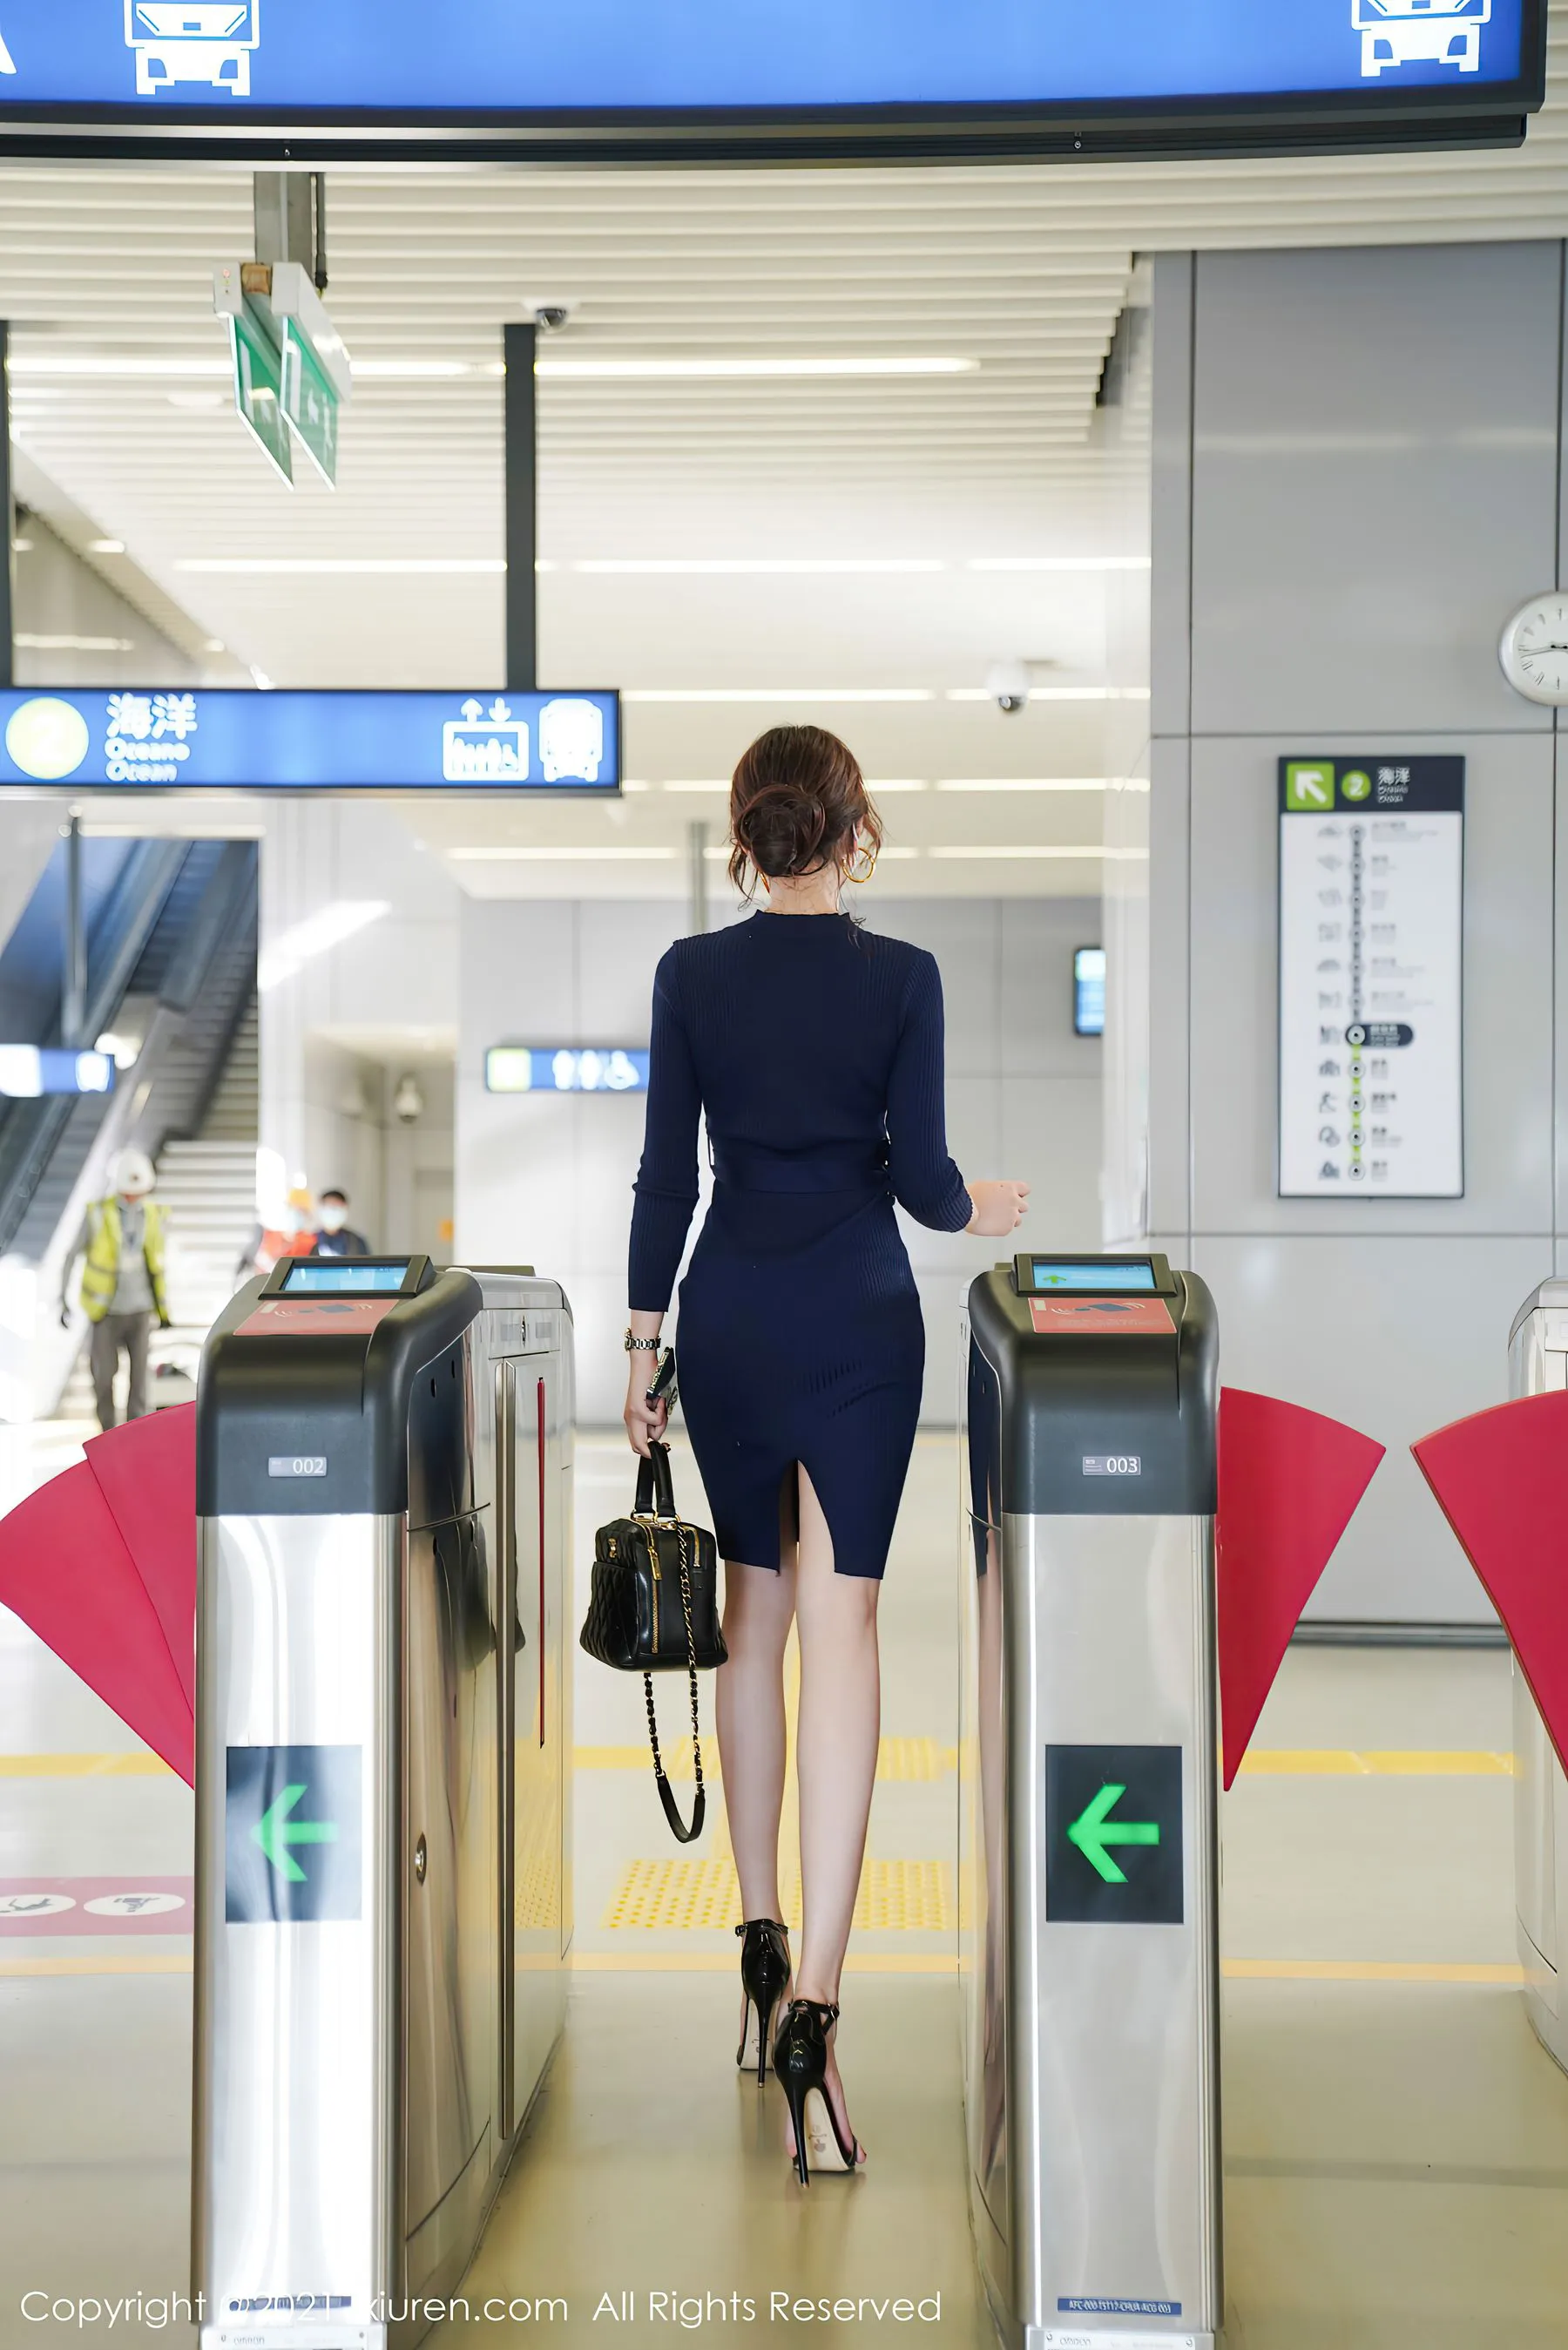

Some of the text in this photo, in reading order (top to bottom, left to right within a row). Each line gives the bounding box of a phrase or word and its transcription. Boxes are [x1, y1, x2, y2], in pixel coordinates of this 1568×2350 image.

[105, 693, 199, 741] 海洋
[1350, 774, 1364, 796] 2
[293, 1459, 324, 1473] 002
[1107, 1458, 1138, 1473] 003
